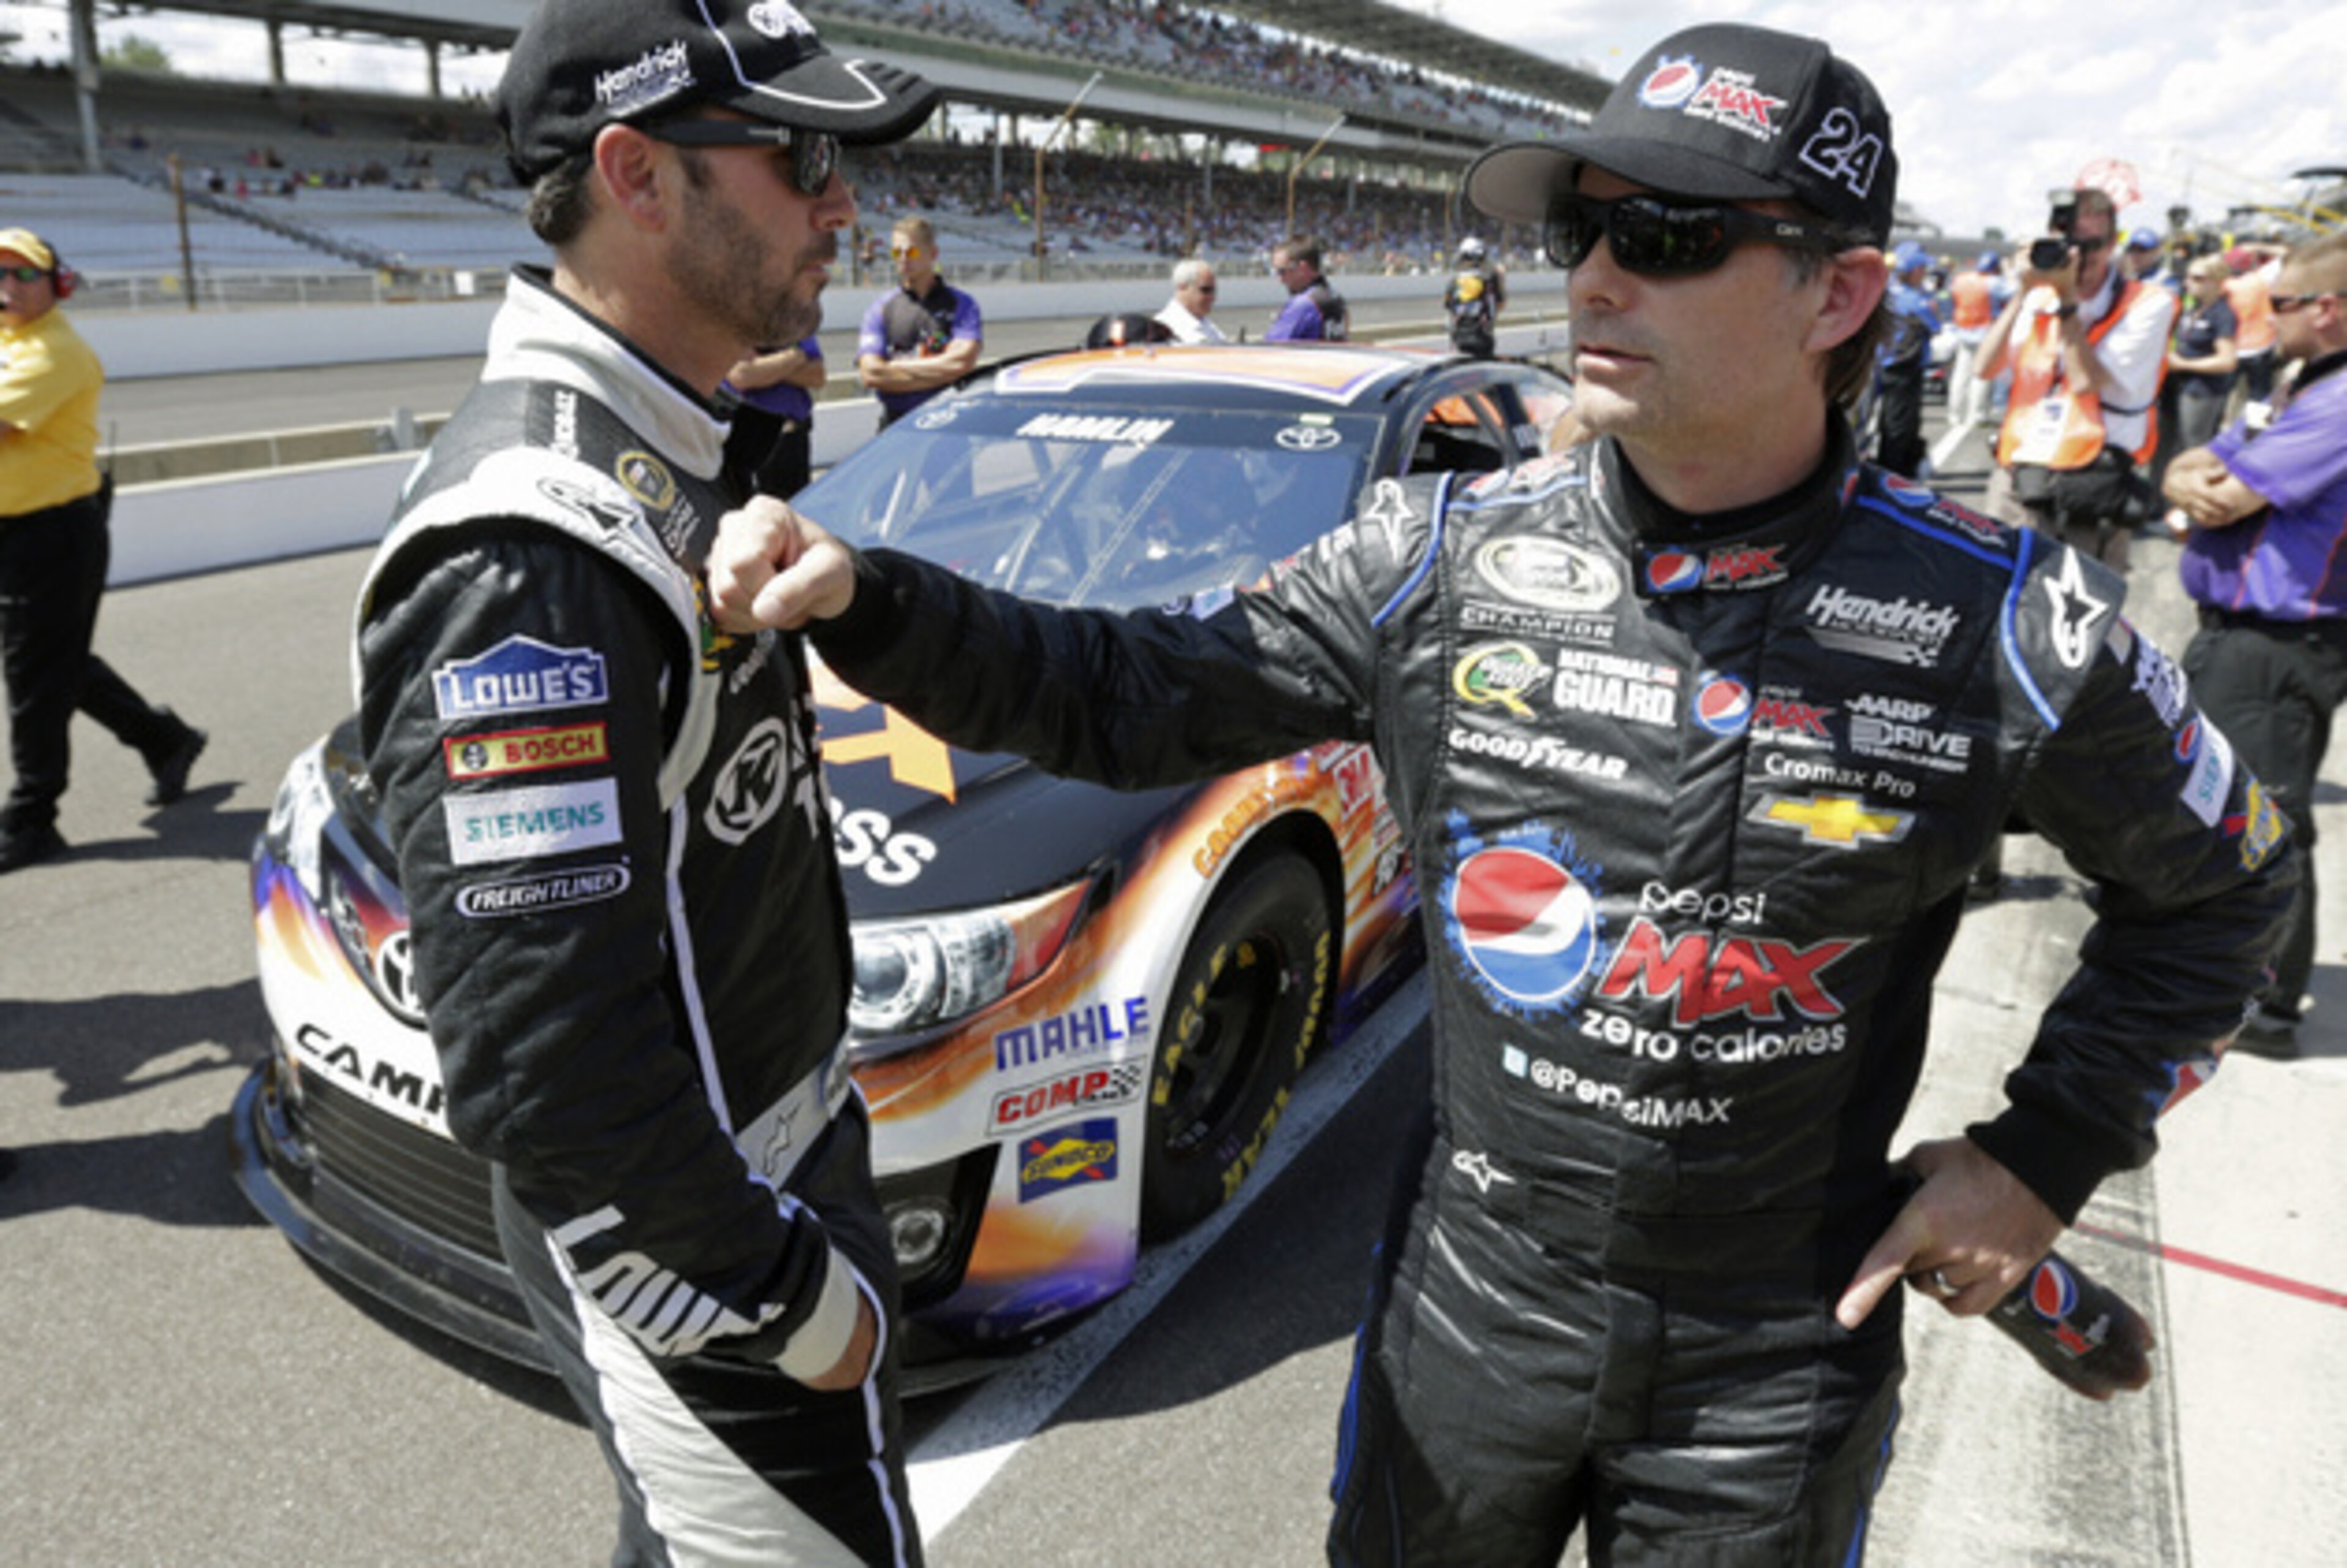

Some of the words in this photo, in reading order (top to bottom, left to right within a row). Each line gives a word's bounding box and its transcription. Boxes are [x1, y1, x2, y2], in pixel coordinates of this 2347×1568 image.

[596, 38, 689, 106] Hendrick
[1689, 78, 1791, 130] MAX
[1799, 107, 1883, 199] 24
[1015, 412, 1175, 443] HAMLIN
[1703, 545, 1787, 582] MAX
[1461, 606, 1615, 640] CHAMPION
[1807, 584, 1960, 637] Hendrick
[449, 661, 595, 709] LOWE'S
[1553, 669, 1678, 727] GUARD
[1751, 698, 1837, 738] MAX
[1851, 714, 1972, 758] DRIVE
[504, 733, 596, 764] BOSCH
[1449, 728, 1628, 780] GOODYEAR
[1765, 752, 1868, 787] Cromax
[1873, 771, 1916, 799] Pro
[465, 802, 606, 843] SIEMENS
[830, 796, 938, 886] ss
[471, 869, 616, 911] FREIGHTLINER
[1639, 881, 1766, 925] pepsi
[1593, 914, 1871, 1030] MAX
[995, 997, 1148, 1072] MAHLE
[1579, 1008, 1678, 1061] zero
[1689, 1023, 1846, 1063] calories
[997, 1071, 1109, 1124] COMP
[1530, 1058, 1734, 1127] @PepsiMAX
